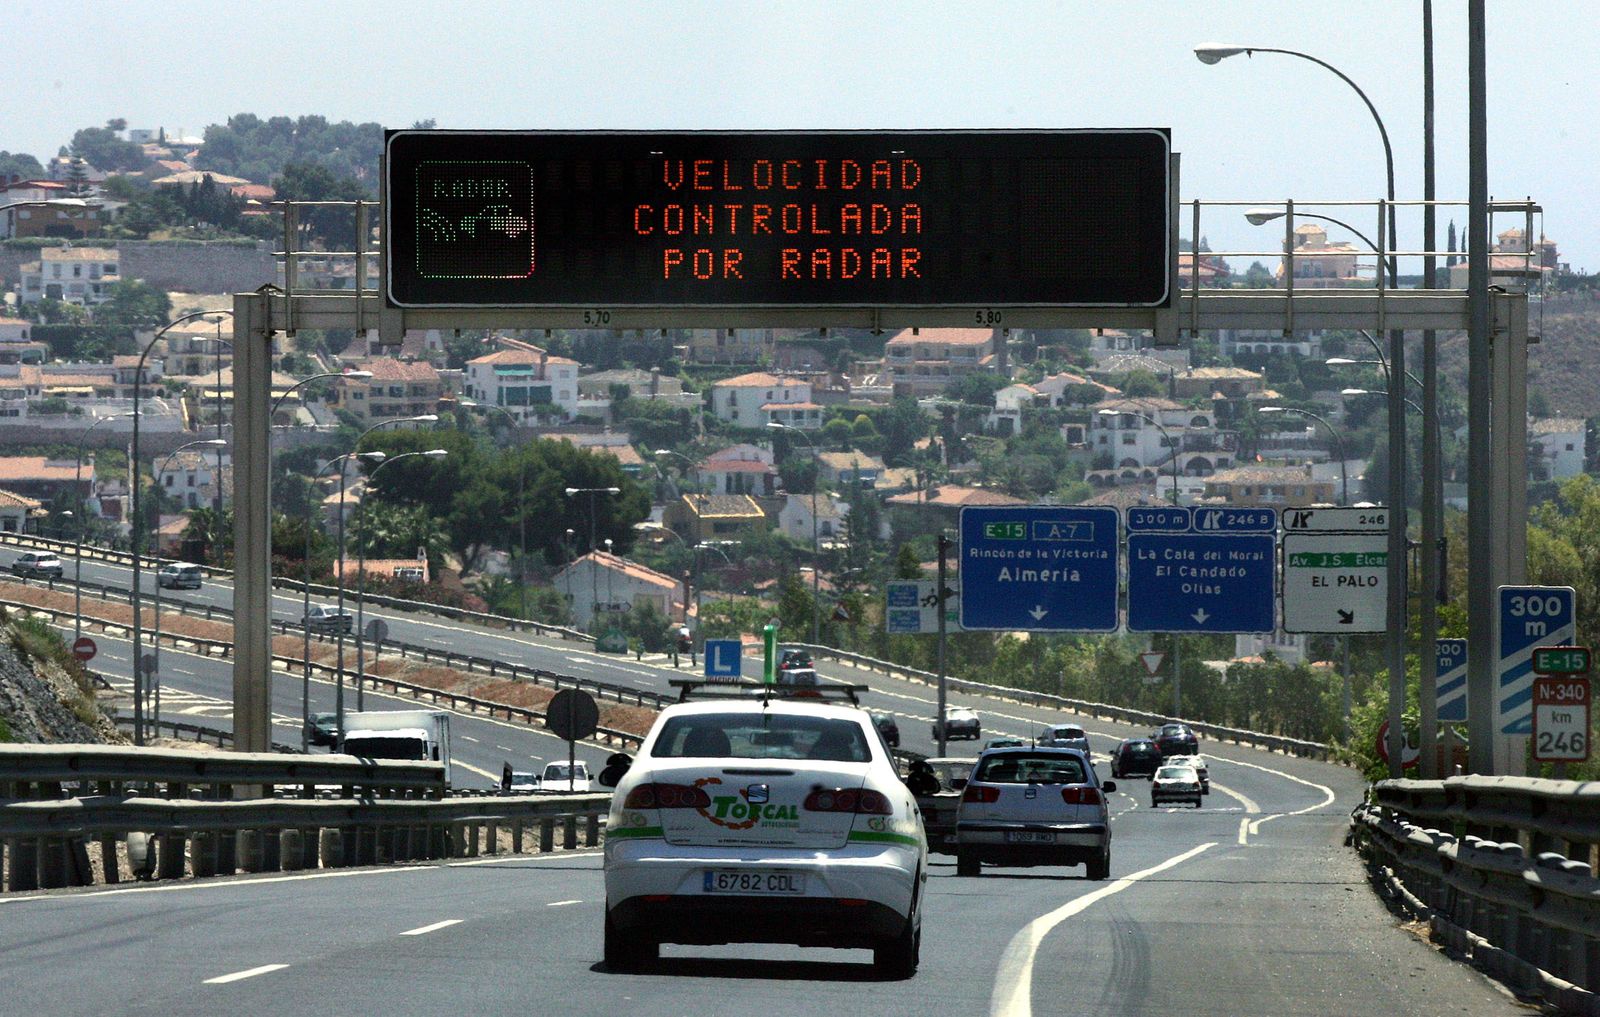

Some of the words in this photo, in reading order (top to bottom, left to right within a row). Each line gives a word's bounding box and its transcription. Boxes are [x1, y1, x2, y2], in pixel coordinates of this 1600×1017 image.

[663, 159, 921, 191] VELOCIDAD
[434, 179, 512, 198] RADAR
[634, 204, 921, 235] CONTROLADA
[663, 248, 744, 280] POR
[782, 248, 921, 280] RADAR
[584, 311, 610, 324] 5.70
[975, 311, 1002, 324] 5.80
[1136, 514, 1166, 525] 300
[1172, 515, 1183, 525] m
[1227, 514, 1255, 525] 246
[1260, 515, 1269, 524] B
[1359, 515, 1385, 525] 246
[985, 524, 1024, 538] E-15
[1049, 524, 1078, 538] A-7
[1018, 549, 1032, 559] de
[1036, 549, 1048, 559] la
[1053, 549, 1108, 560] Victoria
[1138, 548, 1156, 560] La
[1164, 548, 1195, 560] Cala
[1203, 550, 1221, 561] del
[1229, 550, 1264, 561] Moral
[1291, 555, 1311, 566] Av.
[1320, 555, 1345, 566] J.S.
[1156, 565, 1171, 577] El
[1179, 565, 1247, 578] Candado
[1312, 576, 1329, 587] EL
[1337, 575, 1379, 588] PALO
[1510, 595, 1562, 617] 300
[1525, 620, 1547, 637] m
[714, 645, 732, 672] L
[1440, 657, 1452, 667] m
[1539, 653, 1584, 670] E-15
[1539, 683, 1585, 700] N-340
[1551, 710, 1572, 725] km
[1538, 731, 1584, 753] 246
[718, 874, 761, 891] 6782
[766, 875, 797, 892] CDL
